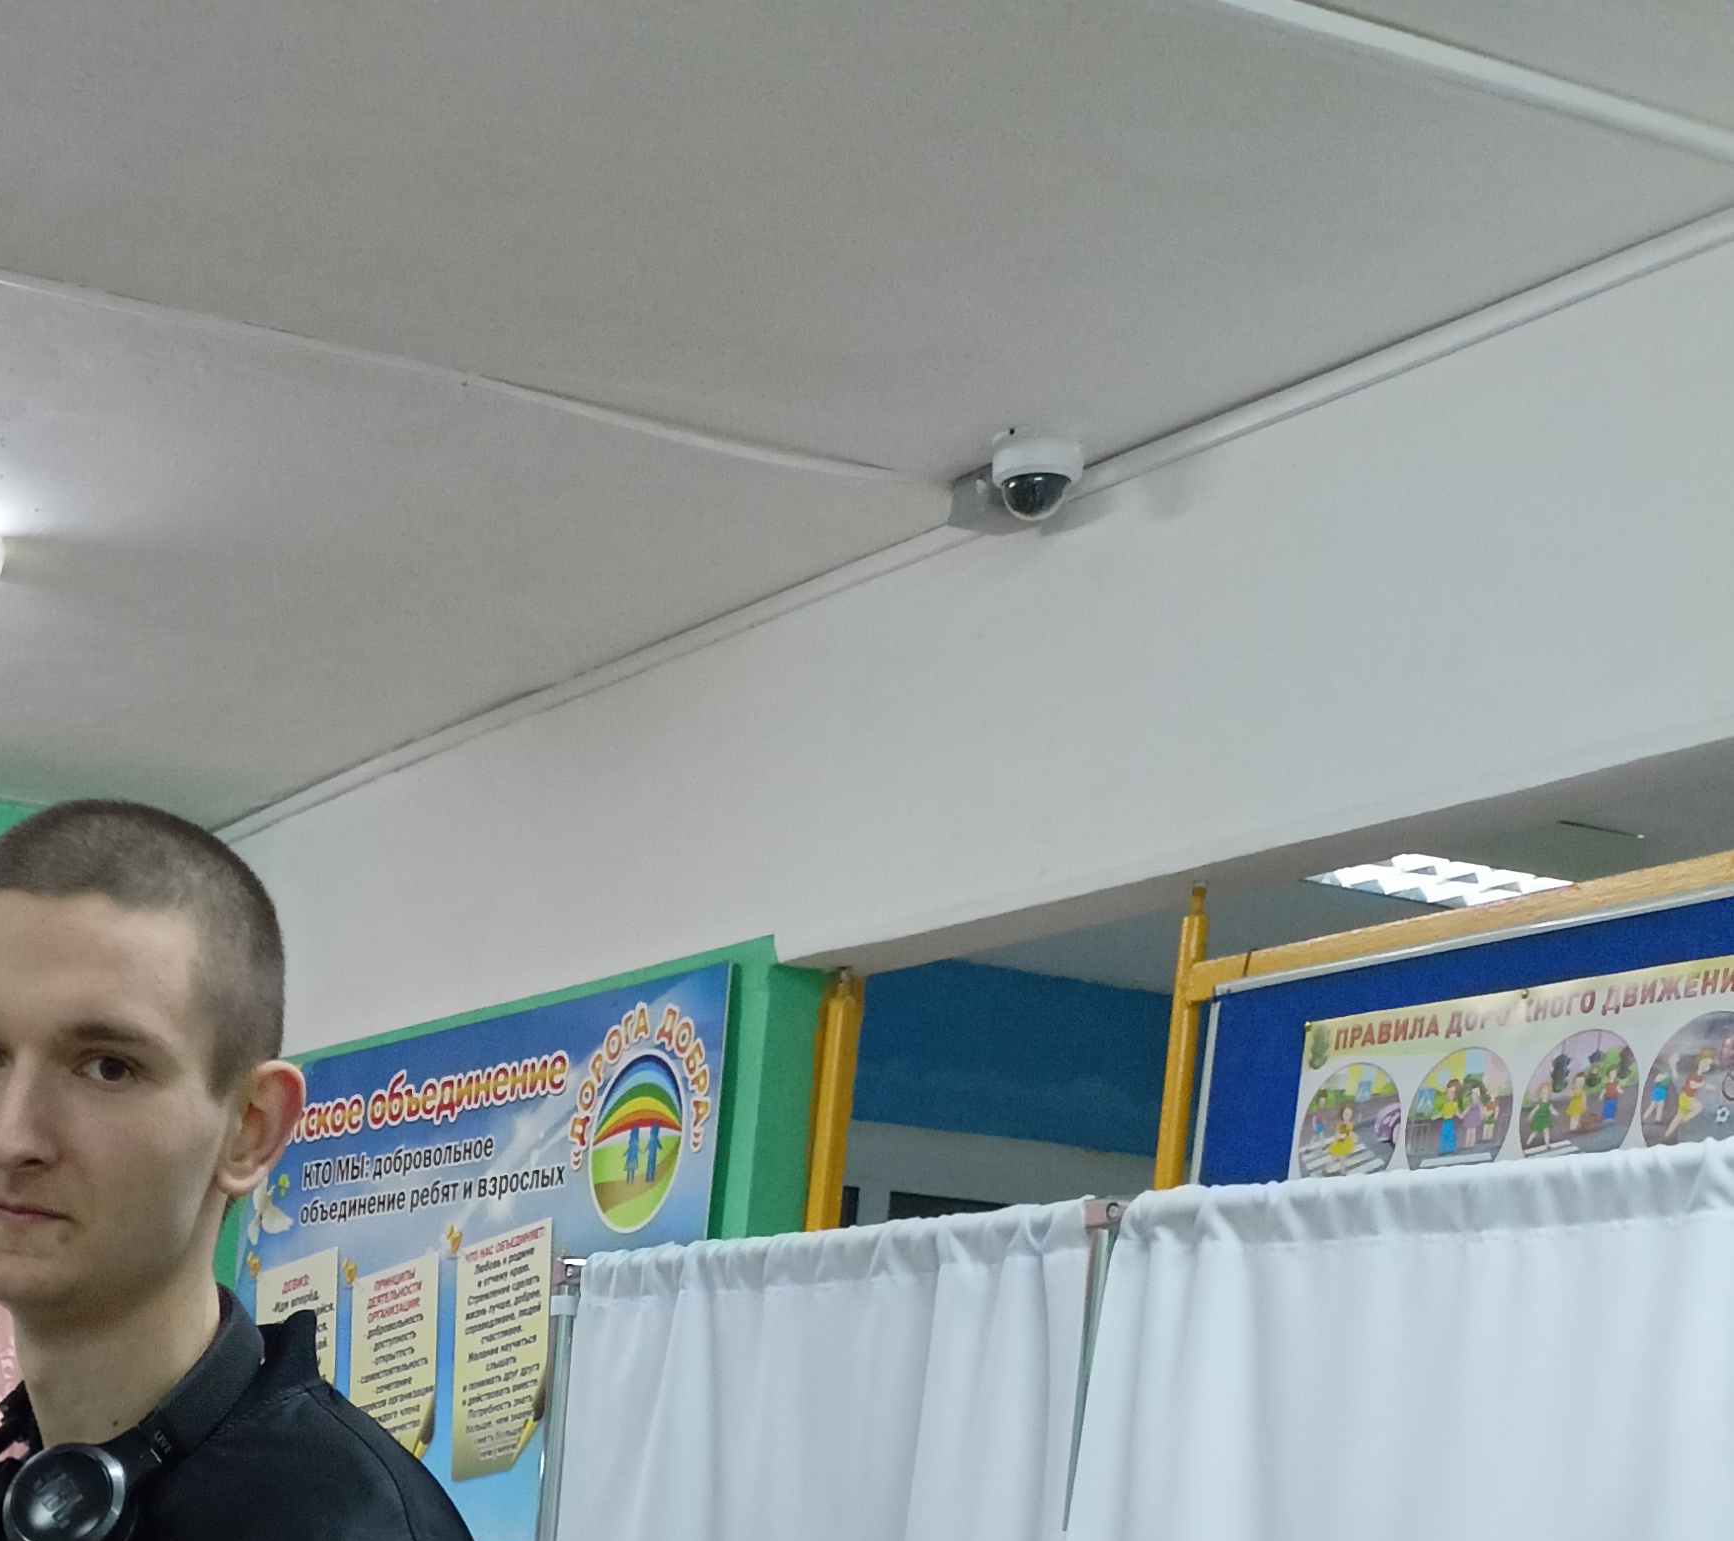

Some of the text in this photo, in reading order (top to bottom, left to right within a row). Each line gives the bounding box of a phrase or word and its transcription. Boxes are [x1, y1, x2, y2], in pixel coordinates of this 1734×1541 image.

[1334, 1017, 1440, 1050] ПРАВИЛА
[1446, 989, 1595, 1039] ДОРОНОГО
[295, 1055, 566, 1137] тское объединение
[302, 1138, 494, 1189] КТО МЫ: добровольное
[300, 1165, 565, 1226] объединение ребят и взрослых
